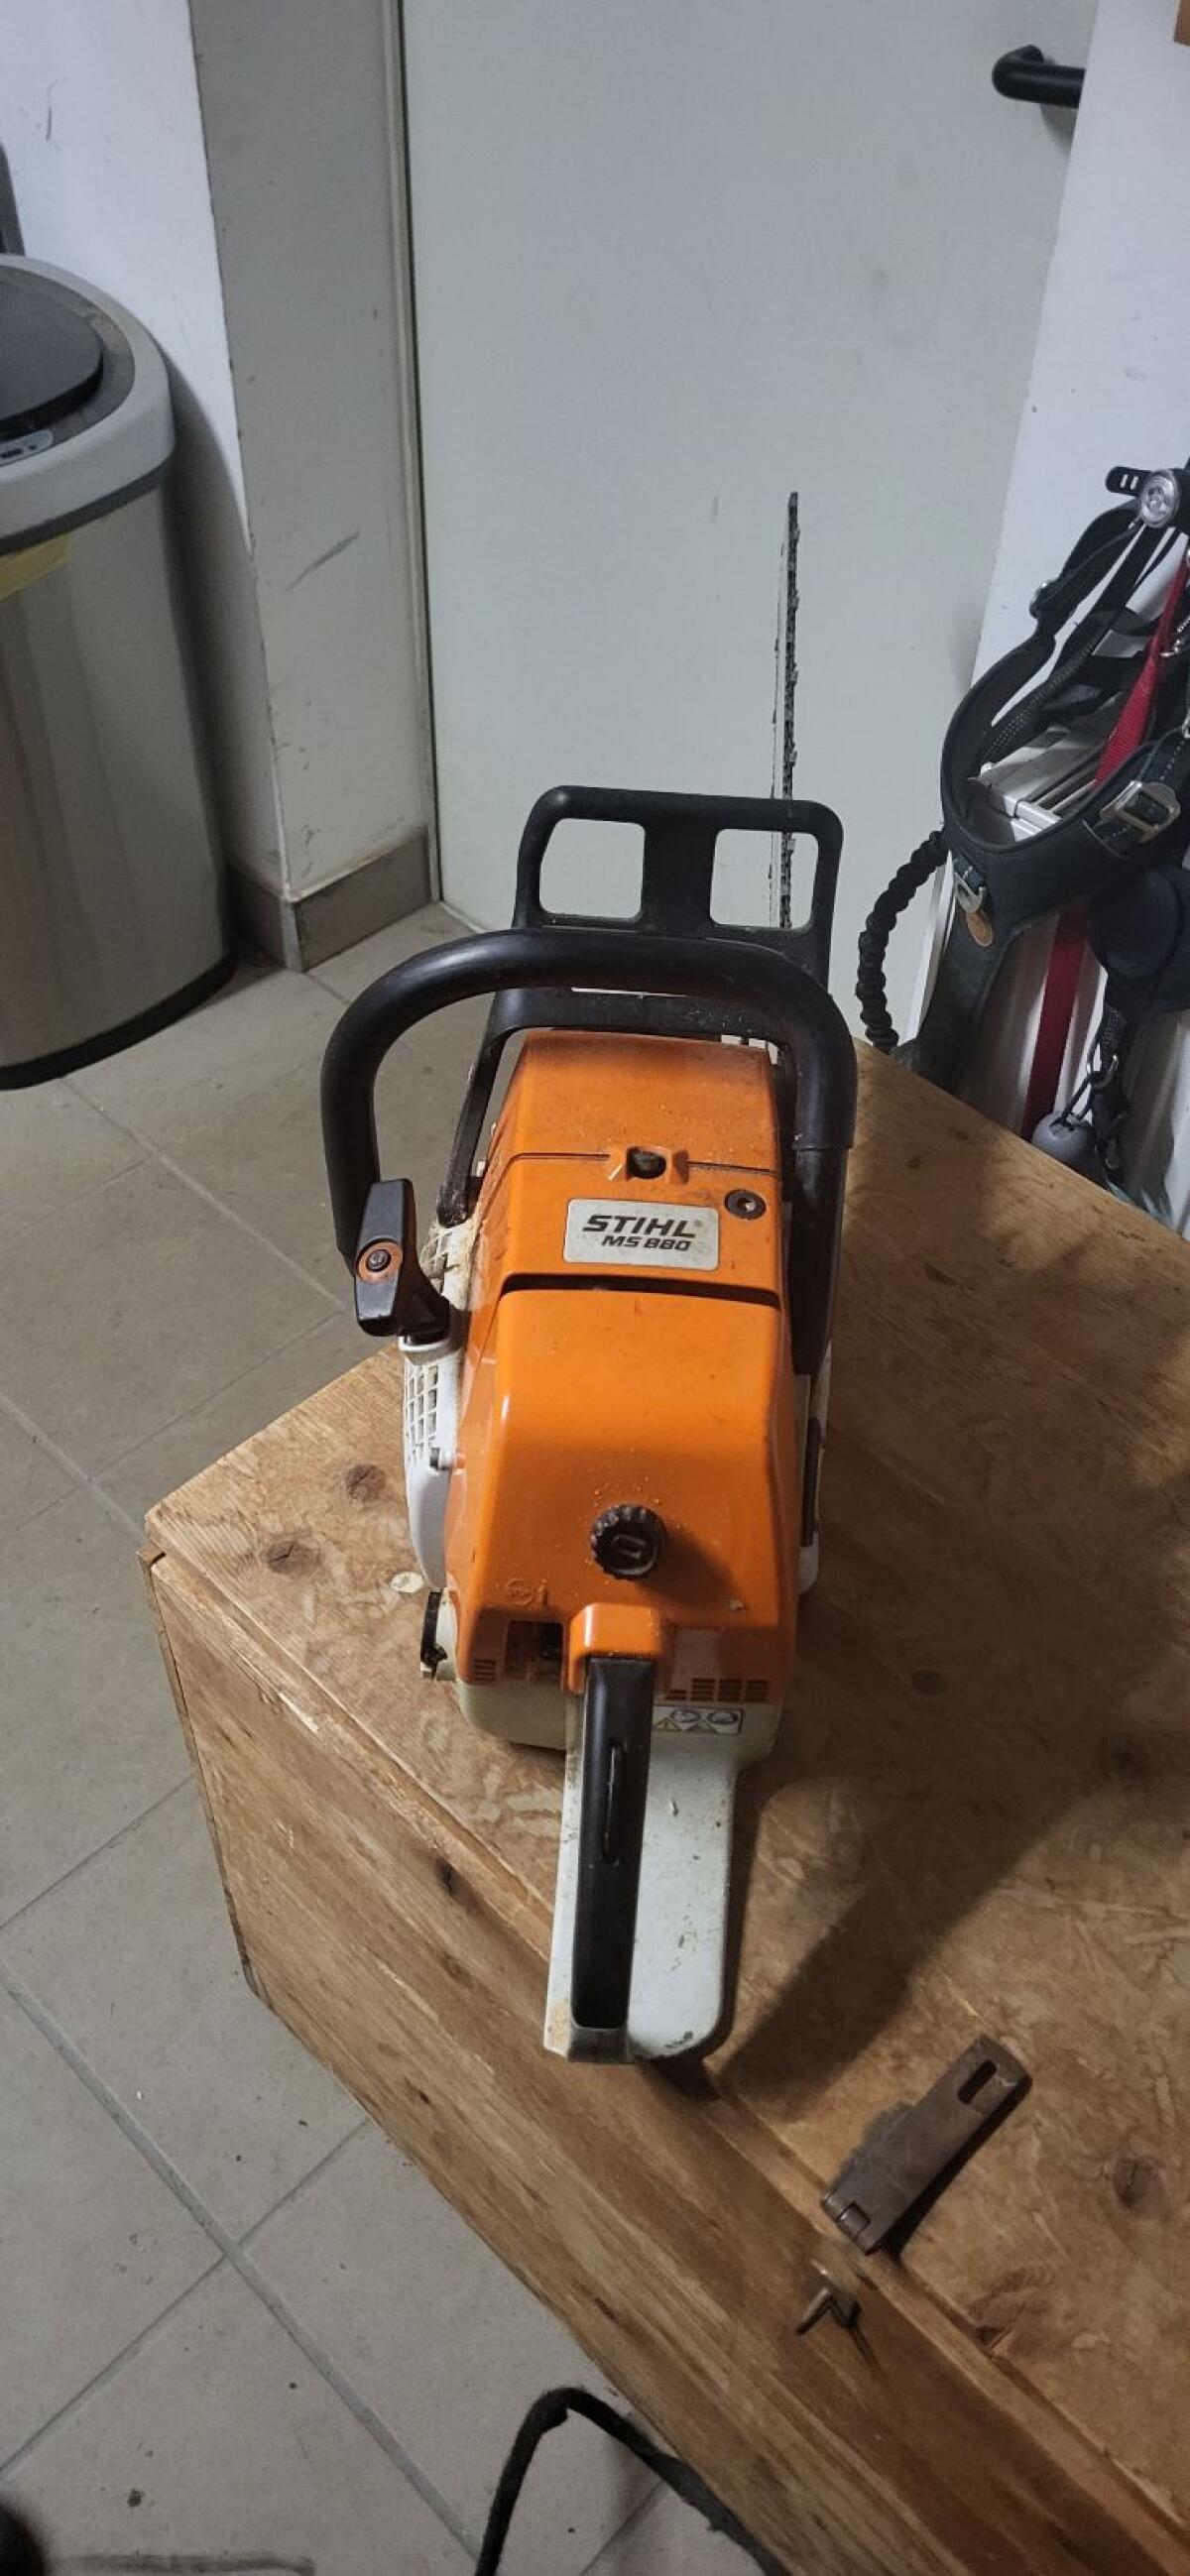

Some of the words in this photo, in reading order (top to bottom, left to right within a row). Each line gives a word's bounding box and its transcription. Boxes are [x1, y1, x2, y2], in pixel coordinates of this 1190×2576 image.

[582, 1215, 696, 1238] STIHL
[601, 1235, 643, 1247] MS
[644, 1238, 692, 1251] 880
